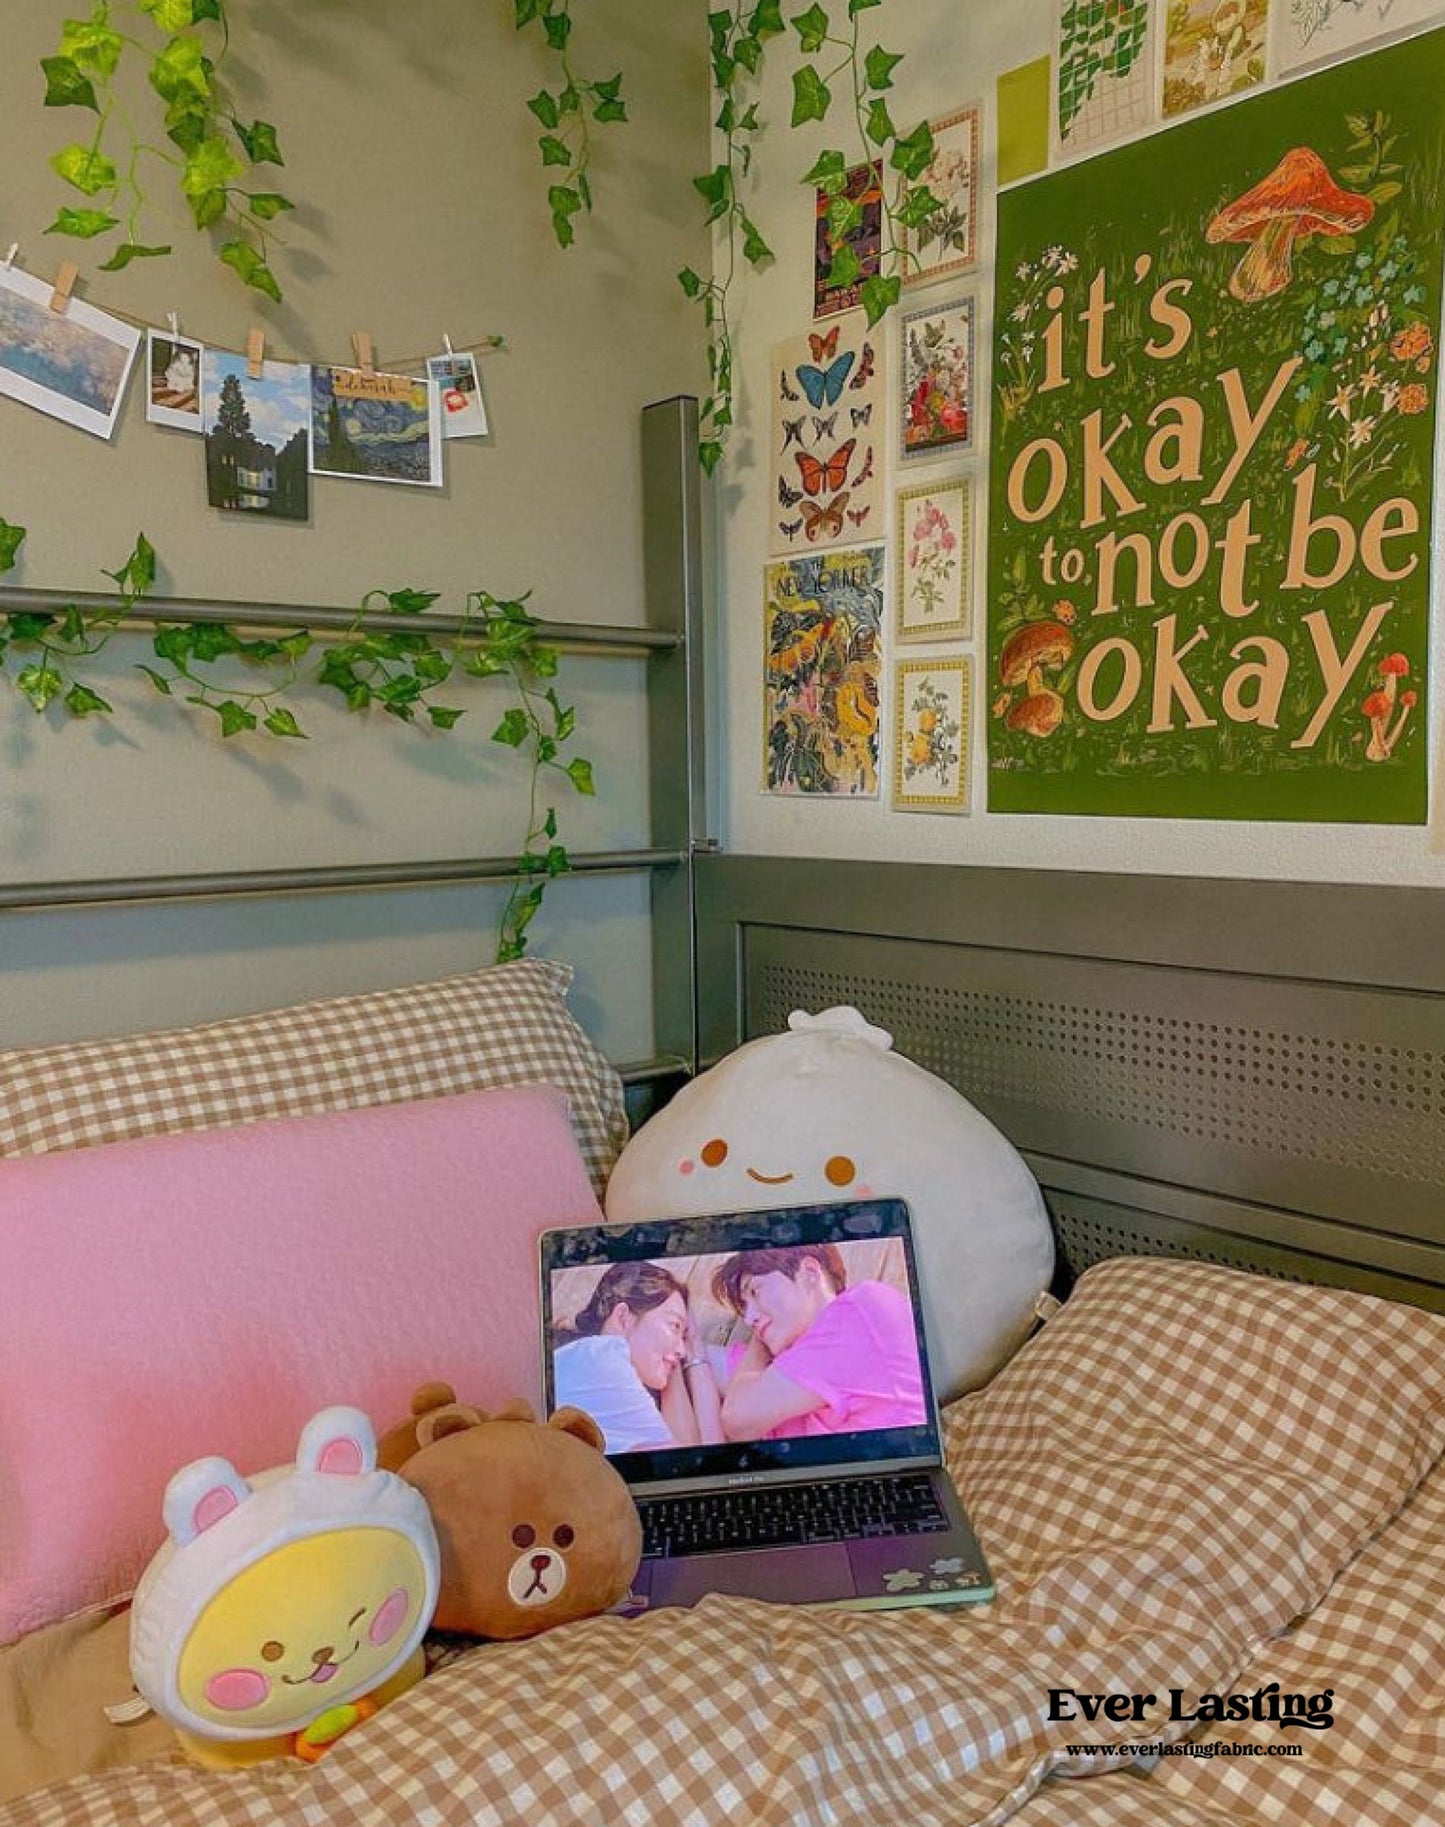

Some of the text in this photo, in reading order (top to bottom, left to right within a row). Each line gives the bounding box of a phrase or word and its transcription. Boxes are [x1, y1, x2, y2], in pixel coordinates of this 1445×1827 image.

[1037, 253, 1194, 394] it's
[1007, 355, 1304, 530] okay
[1039, 462, 1420, 617] to not be
[1076, 601, 1394, 750] okay
